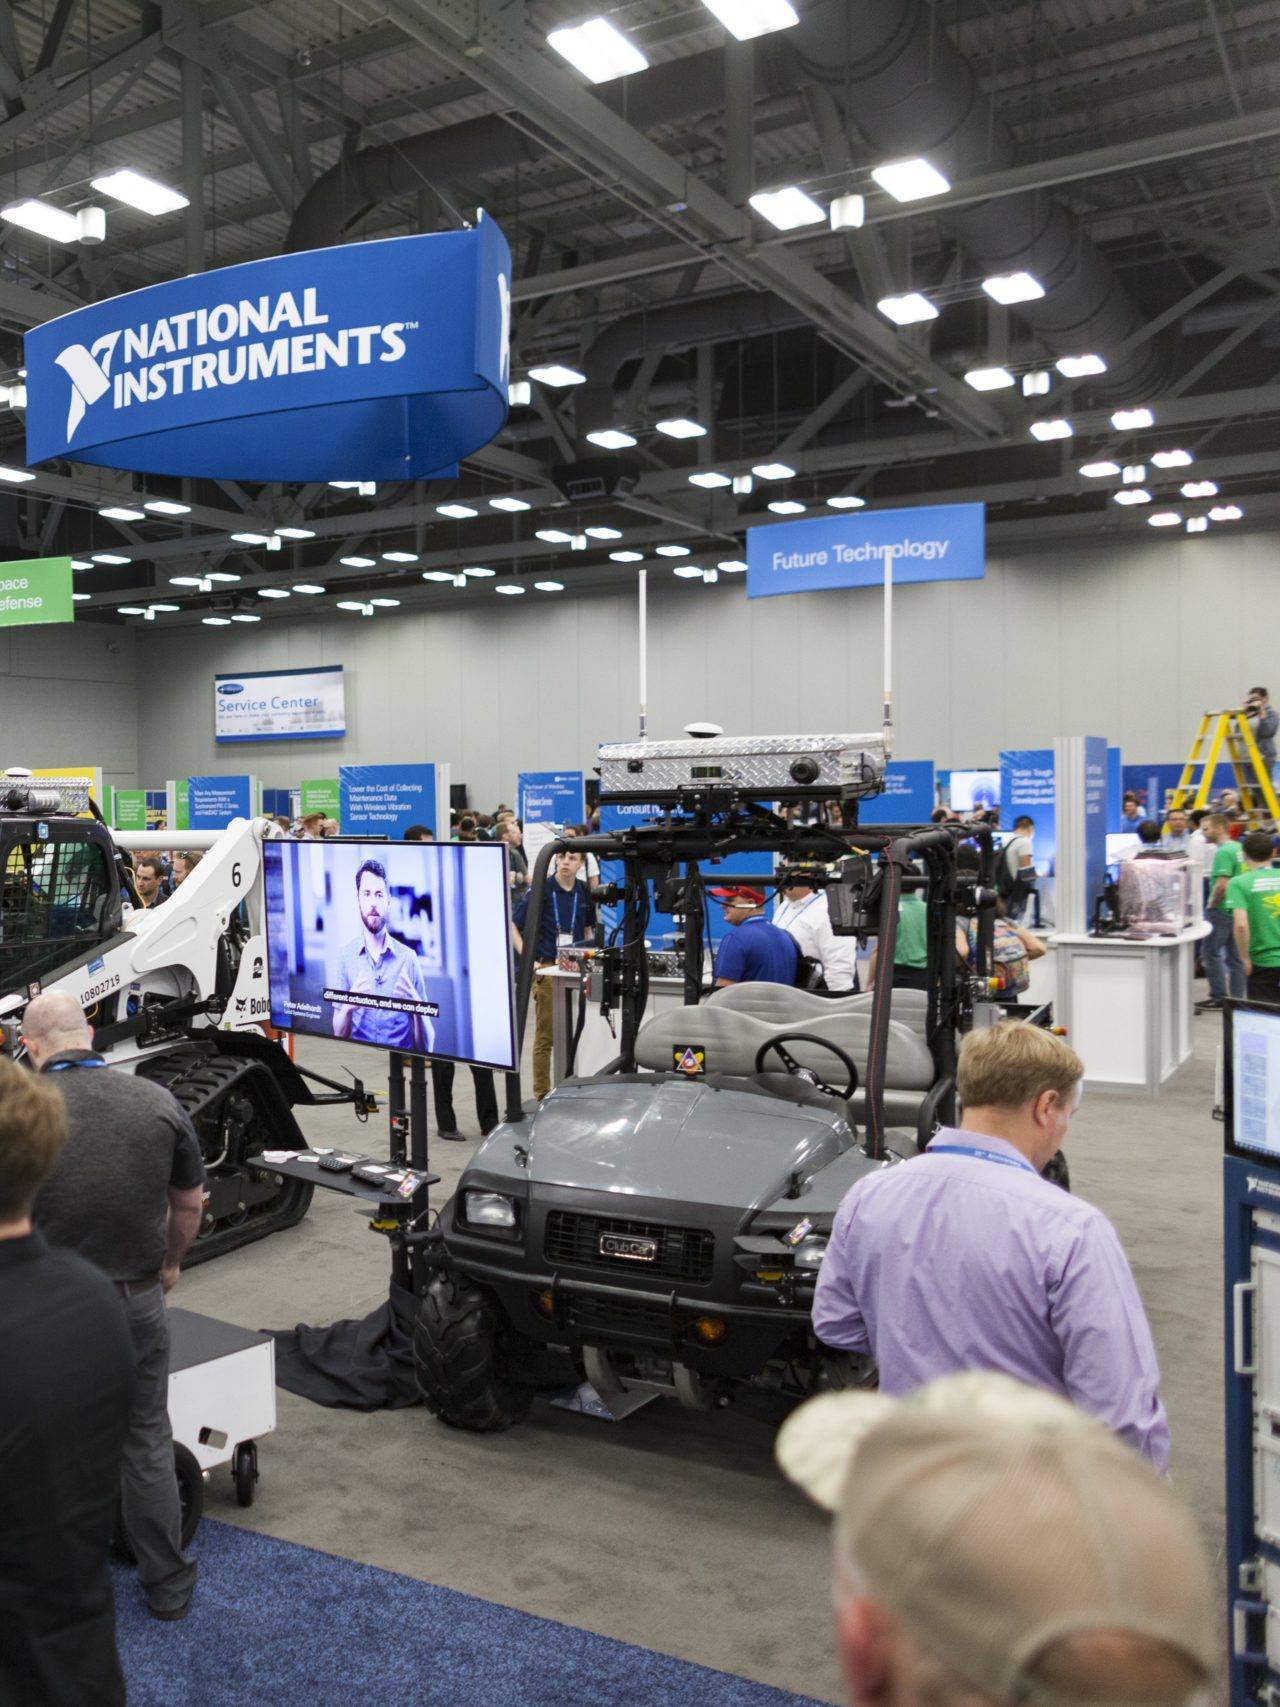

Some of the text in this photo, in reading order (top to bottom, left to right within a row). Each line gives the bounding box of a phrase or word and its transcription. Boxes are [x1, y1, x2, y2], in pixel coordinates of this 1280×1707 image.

[124, 286, 330, 364] NATIONAL
[772, 538, 949, 572] Future Technology
[218, 696, 319, 713] Service Center
[348, 785, 365, 793] Lower
[376, 784, 388, 792] Cost
[389, 784, 396, 792] of
[396, 783, 423, 793] Collecting
[364, 803, 387, 811] Wireless
[387, 803, 412, 811] Vibration
[616, 803, 665, 817] Consultng
[350, 812, 398, 822] Sensor Technology
[231, 862, 242, 888] 6
[252, 956, 263, 979] 2
[80, 974, 121, 1005] 10802719
[283, 1000, 296, 1009] Peter
[323, 990, 439, 1017] different actuators, and we can deploy
[606, 1239, 629, 1253] Club
